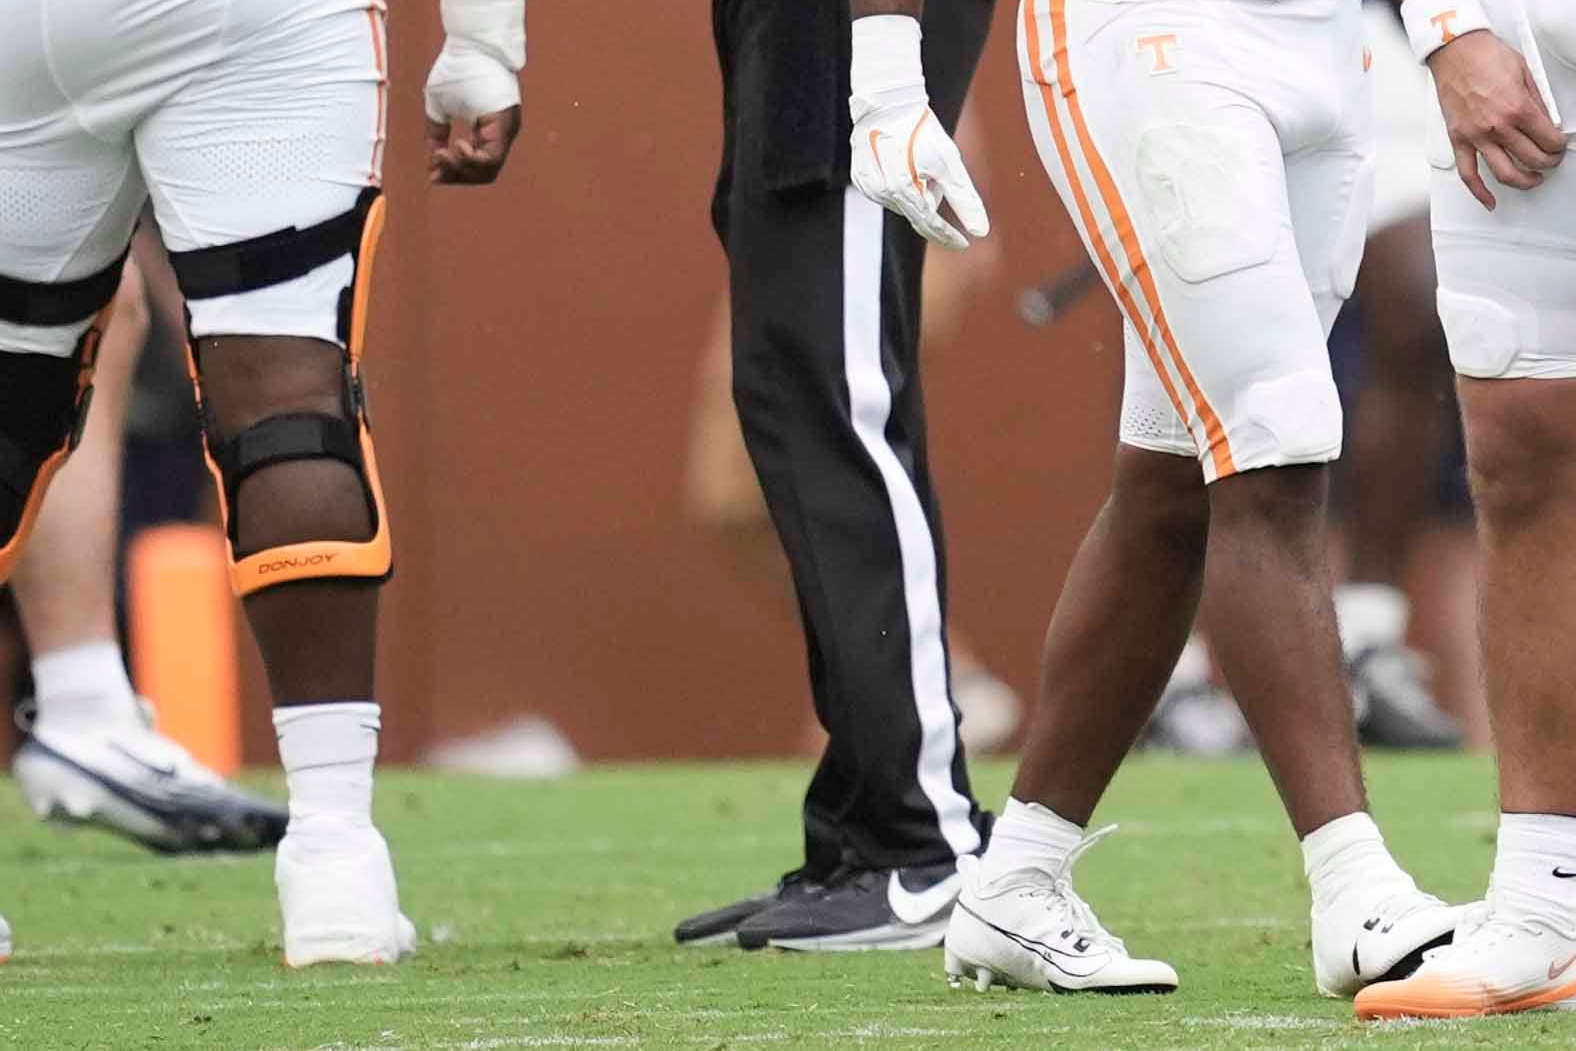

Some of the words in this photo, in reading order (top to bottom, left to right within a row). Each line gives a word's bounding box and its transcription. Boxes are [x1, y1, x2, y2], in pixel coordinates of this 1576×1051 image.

[1429, 9, 1457, 45] T
[1136, 33, 1177, 72] T
[258, 551, 341, 575] DONJOY
